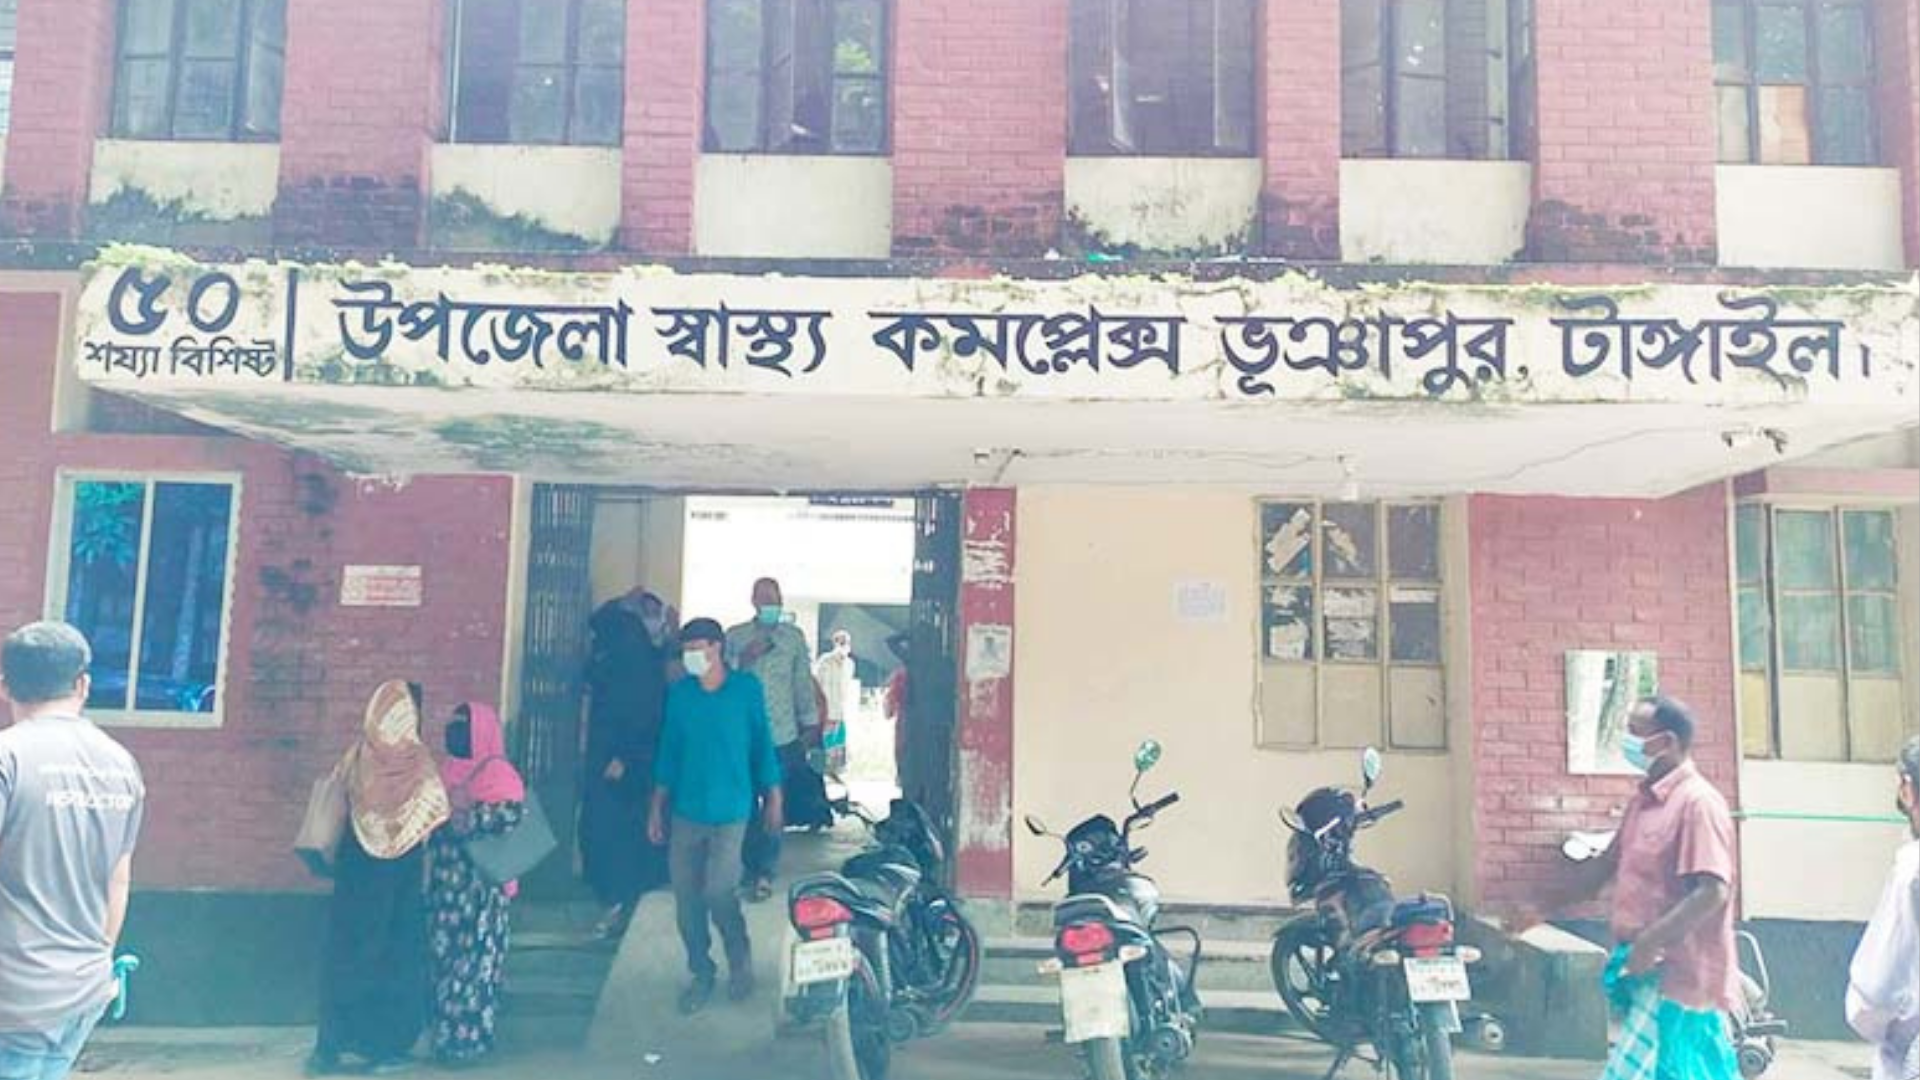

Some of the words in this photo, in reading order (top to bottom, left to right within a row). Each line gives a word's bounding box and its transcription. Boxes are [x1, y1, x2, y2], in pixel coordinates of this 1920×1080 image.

[107, 265, 241, 336] ৫০
[332, 279, 633, 367] উপজেলা
[651, 300, 833, 377] স্বাস্থ্য
[867, 303, 1188, 375] কমপ্লেক্স
[84, 340, 162, 378] শয্যা
[170, 335, 277, 377] বিশিষ্ট
